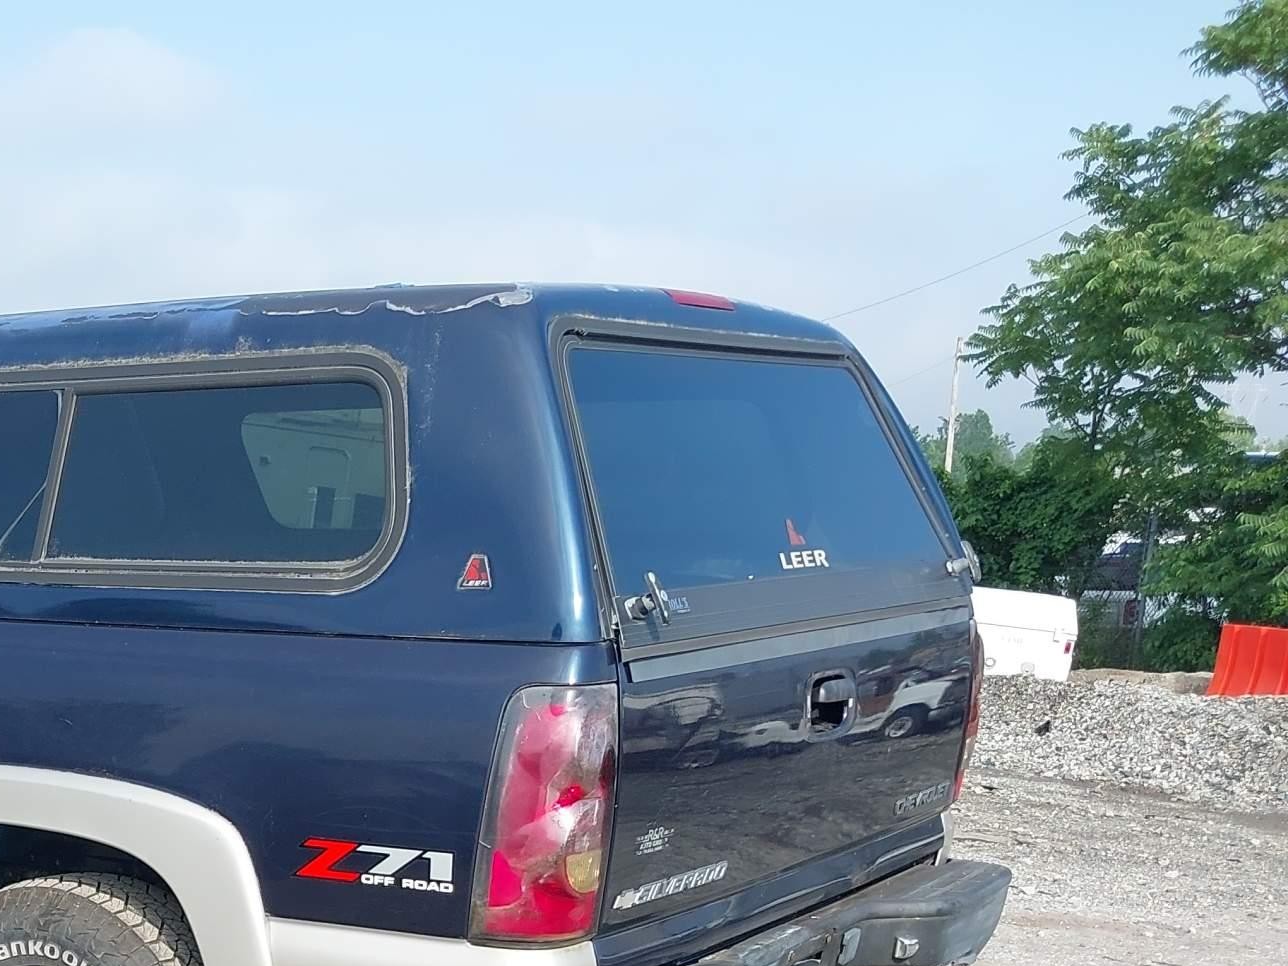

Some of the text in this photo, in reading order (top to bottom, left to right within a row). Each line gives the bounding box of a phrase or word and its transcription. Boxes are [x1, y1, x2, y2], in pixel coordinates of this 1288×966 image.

[779, 549, 830, 570] LEER
[462, 579, 488, 587] LEER
[293, 837, 454, 884] Z71
[360, 873, 454, 894] OFF ROAD
[633, 860, 729, 906] SILVERADO
